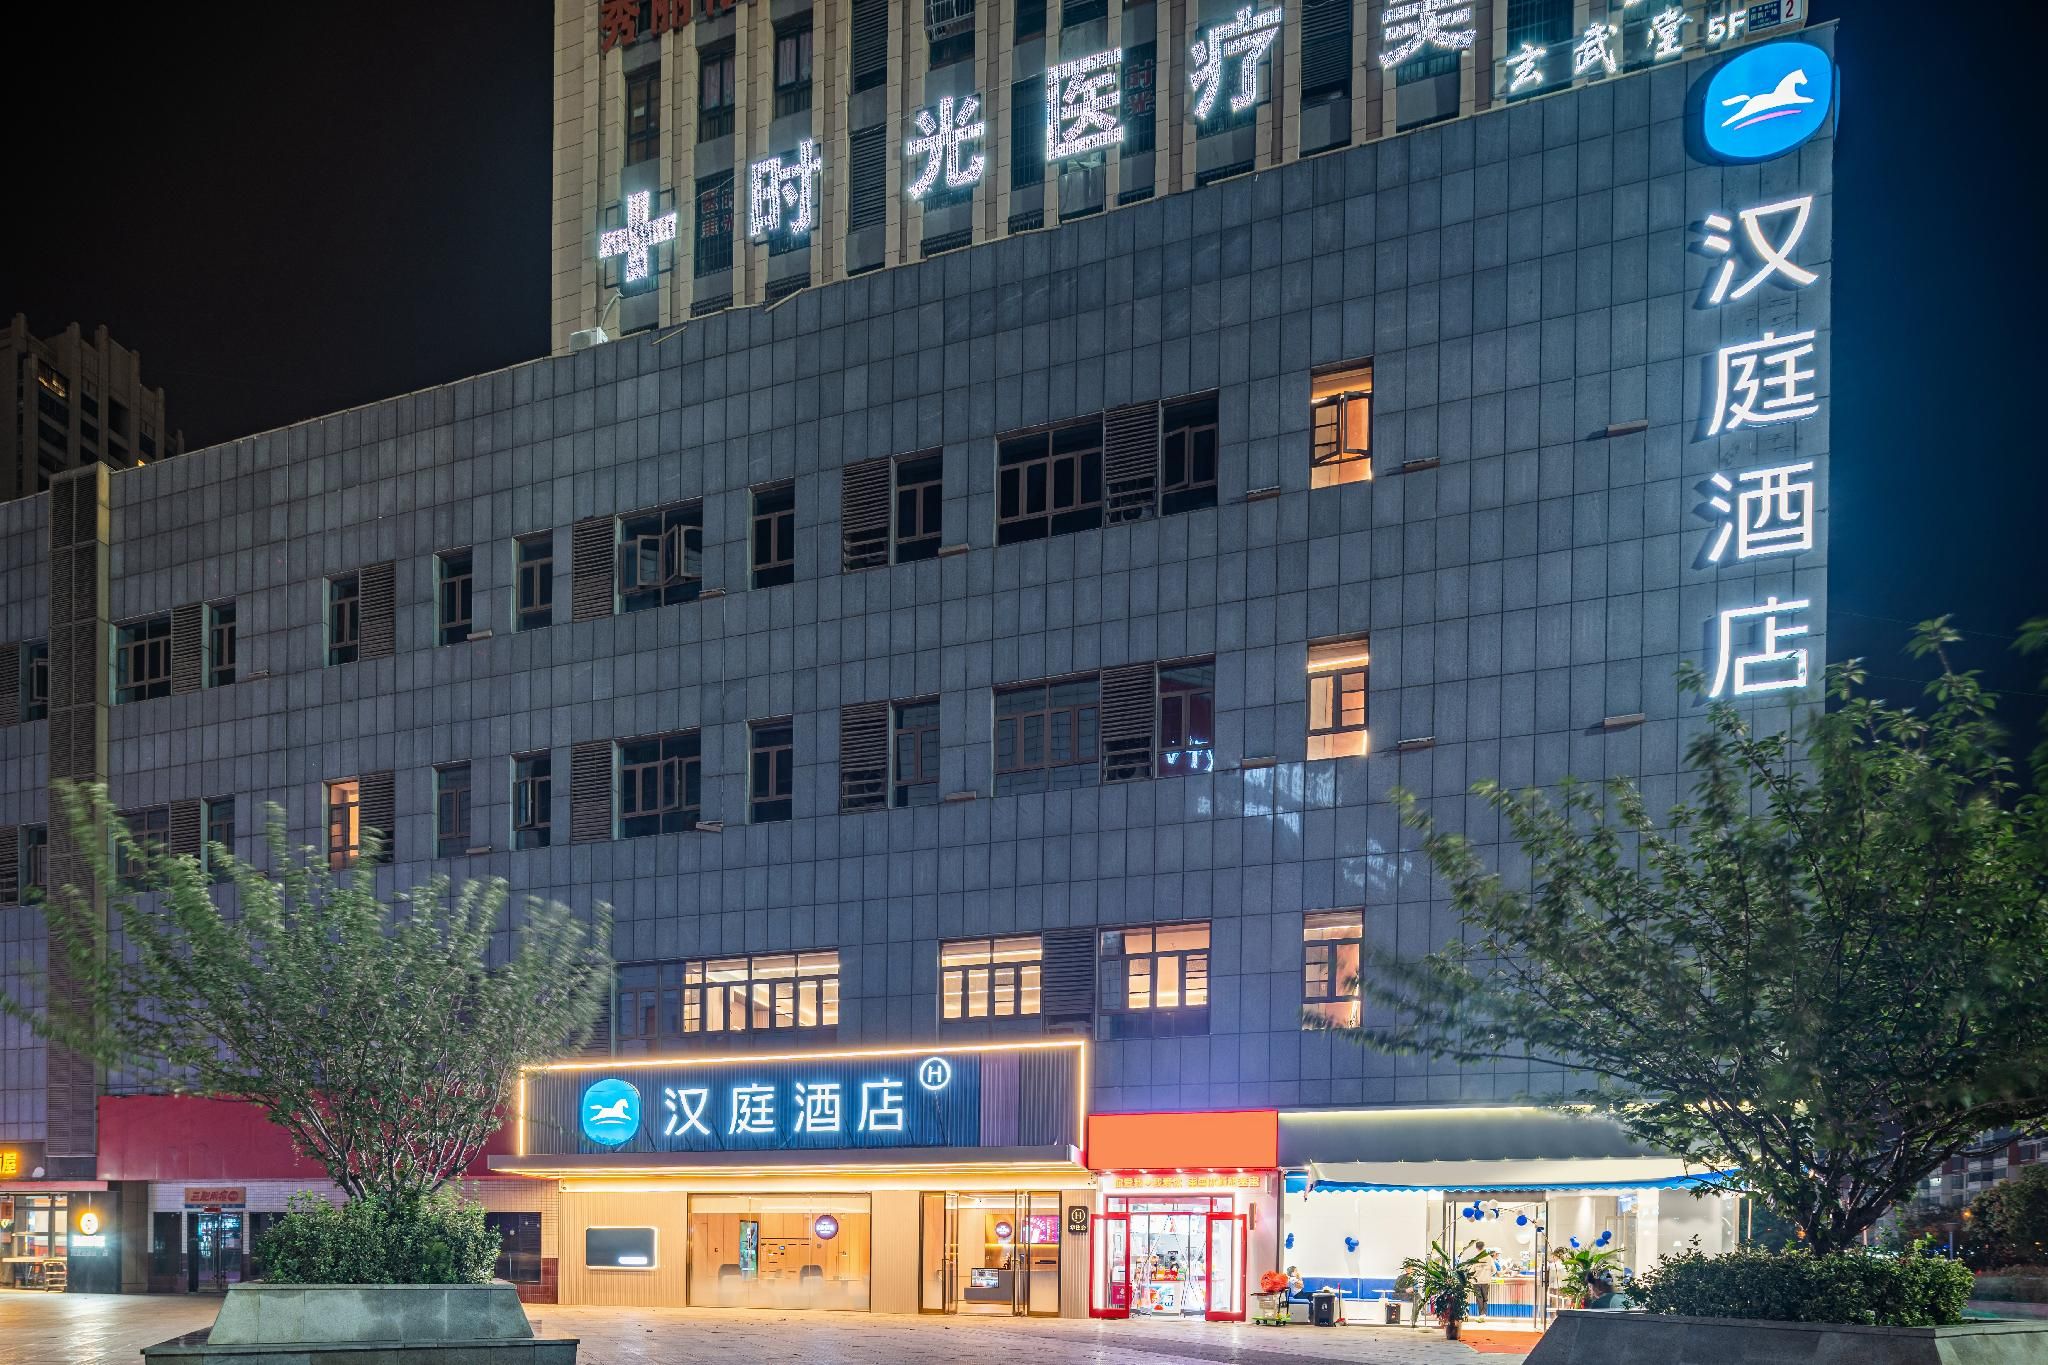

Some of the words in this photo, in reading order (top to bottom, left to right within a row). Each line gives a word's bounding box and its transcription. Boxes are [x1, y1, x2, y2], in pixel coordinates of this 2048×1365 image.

[1506, 6, 1693, 93] 玄武堂
[1708, 10, 1746, 43] 5F
[1703, 195, 1819, 699] 汉庭酒店
[664, 1077, 905, 1136] 汉庭酒店
